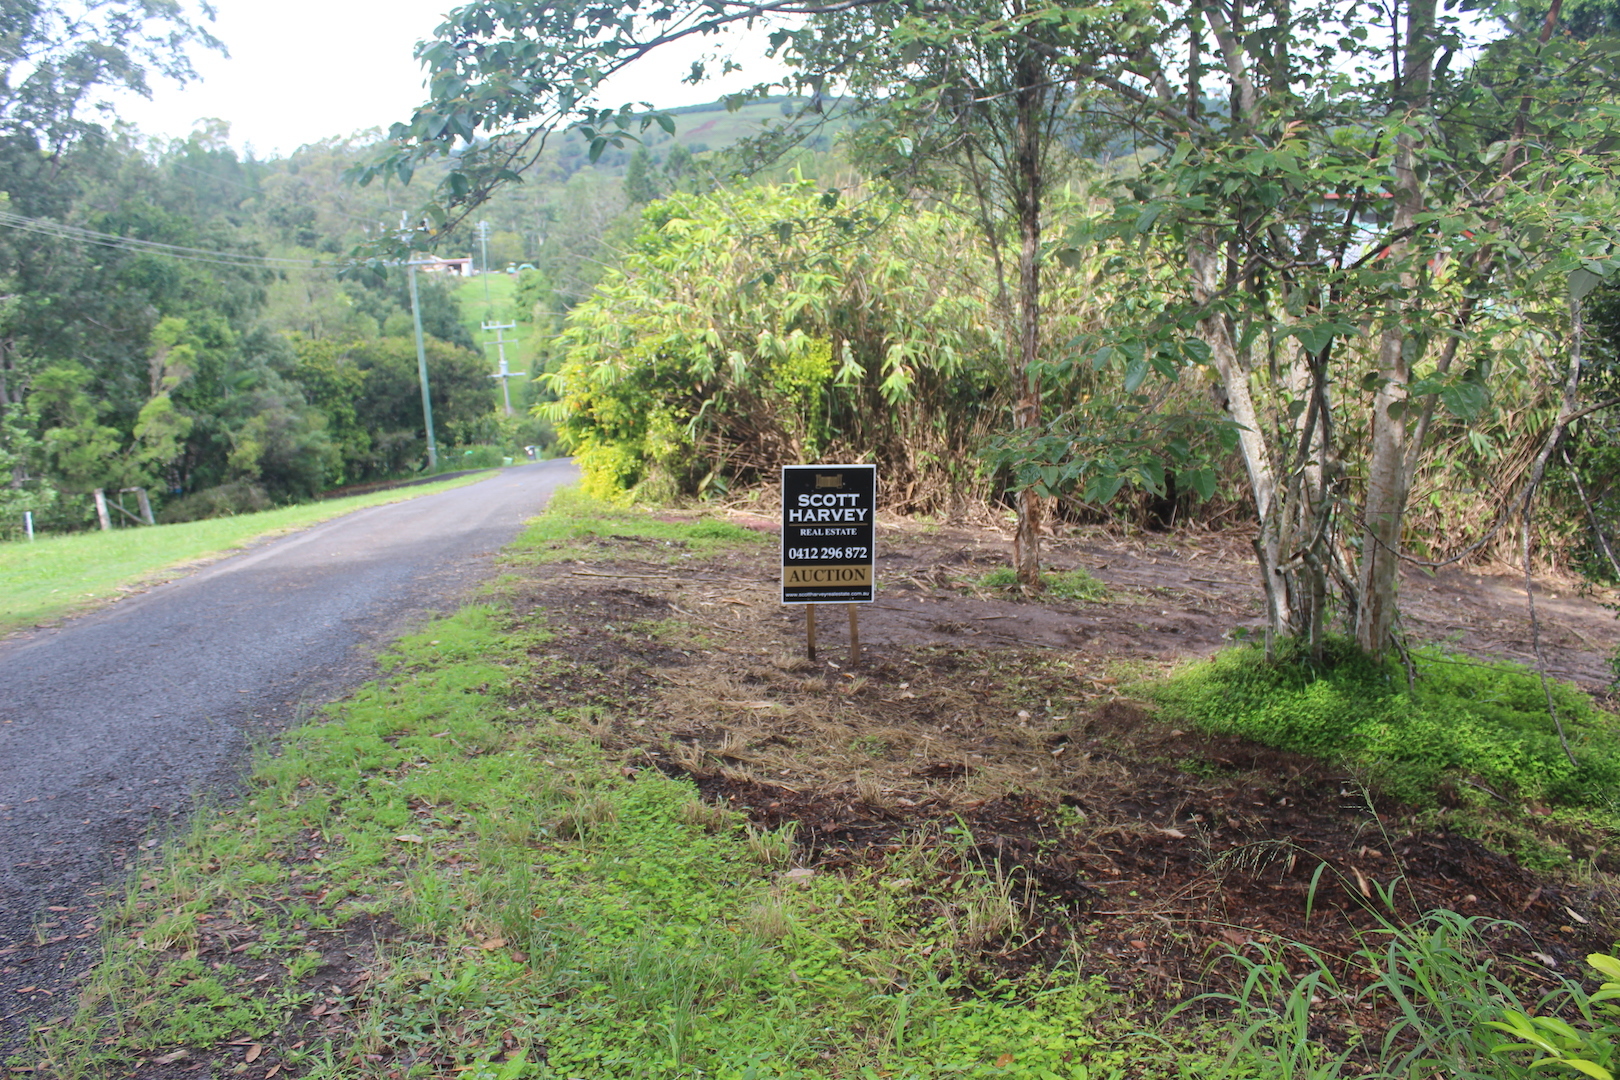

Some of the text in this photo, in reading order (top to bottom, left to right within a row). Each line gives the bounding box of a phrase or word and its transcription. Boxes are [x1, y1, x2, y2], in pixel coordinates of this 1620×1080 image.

[798, 493, 860, 507] SCOTT
[789, 508, 868, 521] HARVEY
[800, 528, 857, 536] REAL ESTATE
[788, 546, 868, 560] 0412 296 872
[789, 568, 866, 582] AUCTION
